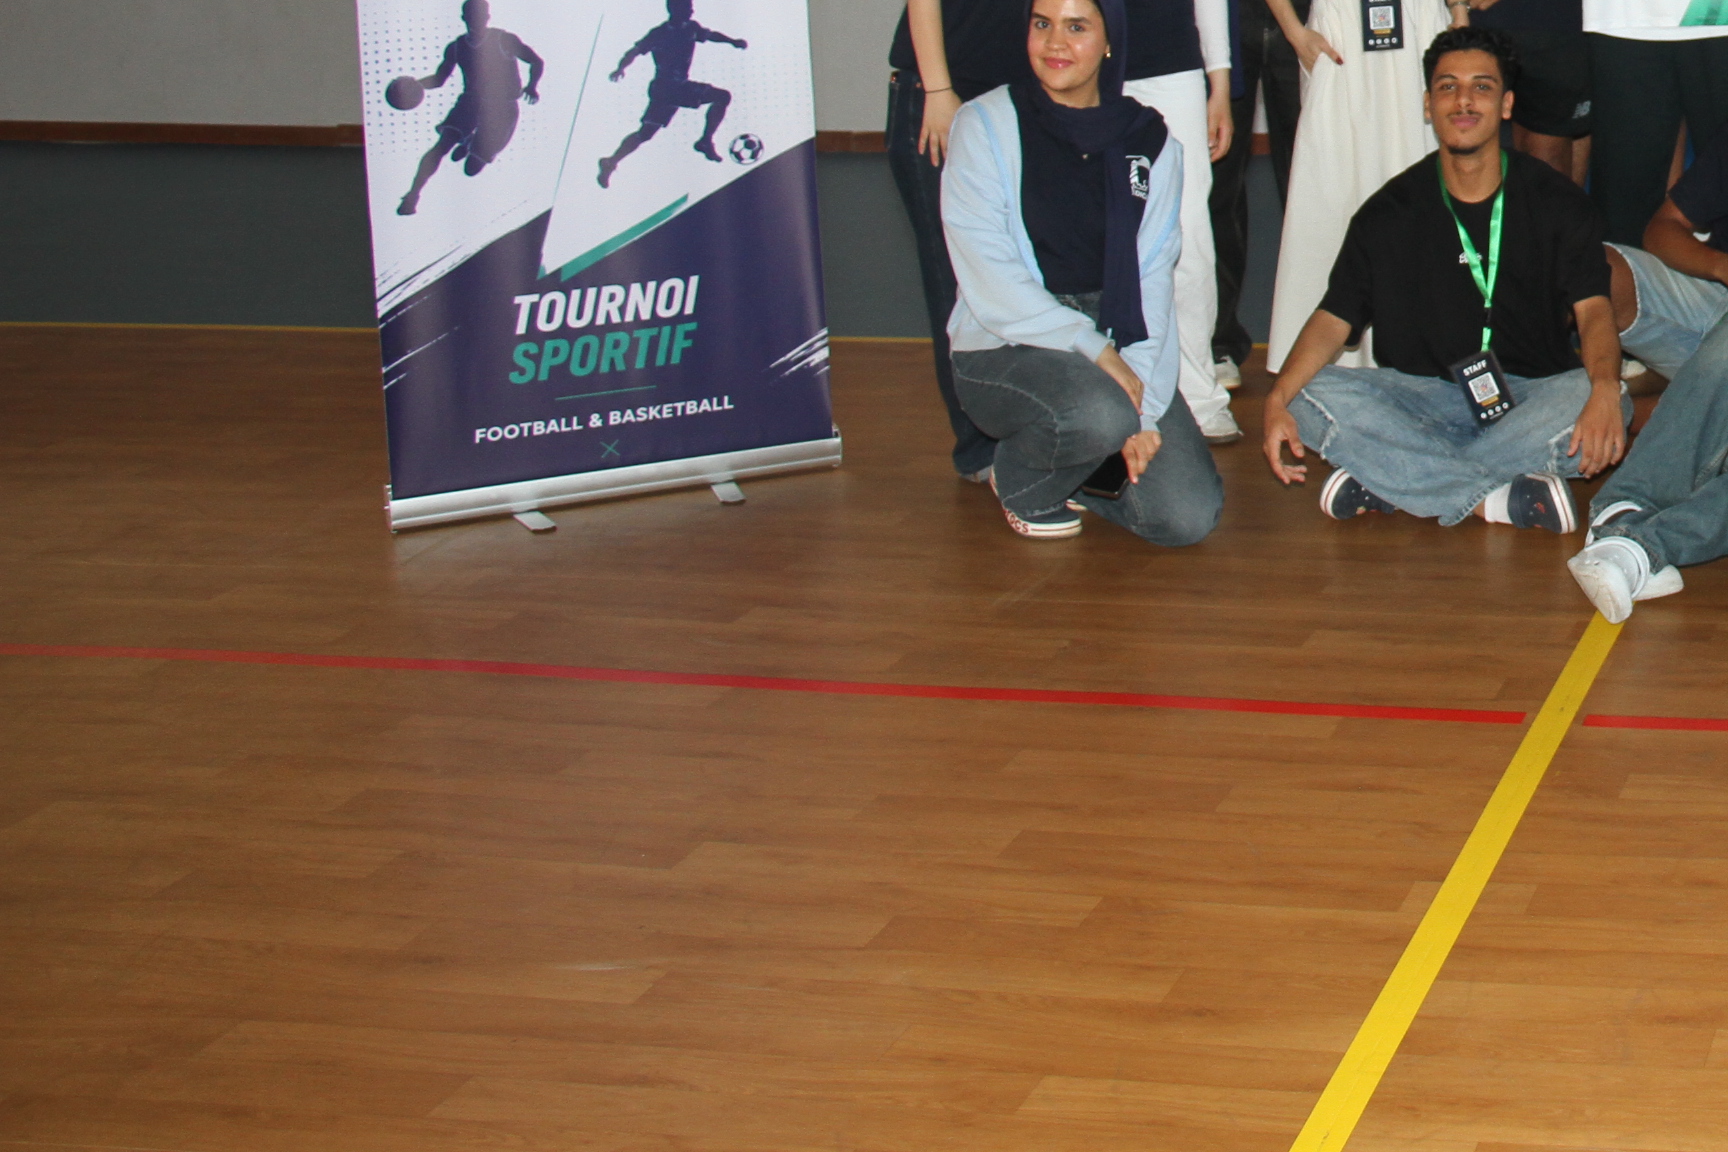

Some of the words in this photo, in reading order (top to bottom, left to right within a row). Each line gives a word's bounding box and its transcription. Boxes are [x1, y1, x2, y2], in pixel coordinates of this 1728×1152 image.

[513, 274, 701, 336] TOURNOI
[508, 322, 698, 385] SPORTIF
[1463, 359, 1488, 377] STAFF
[474, 414, 584, 444] FOOTBALL
[589, 411, 603, 428] &
[608, 395, 734, 425] BASKETBALL
